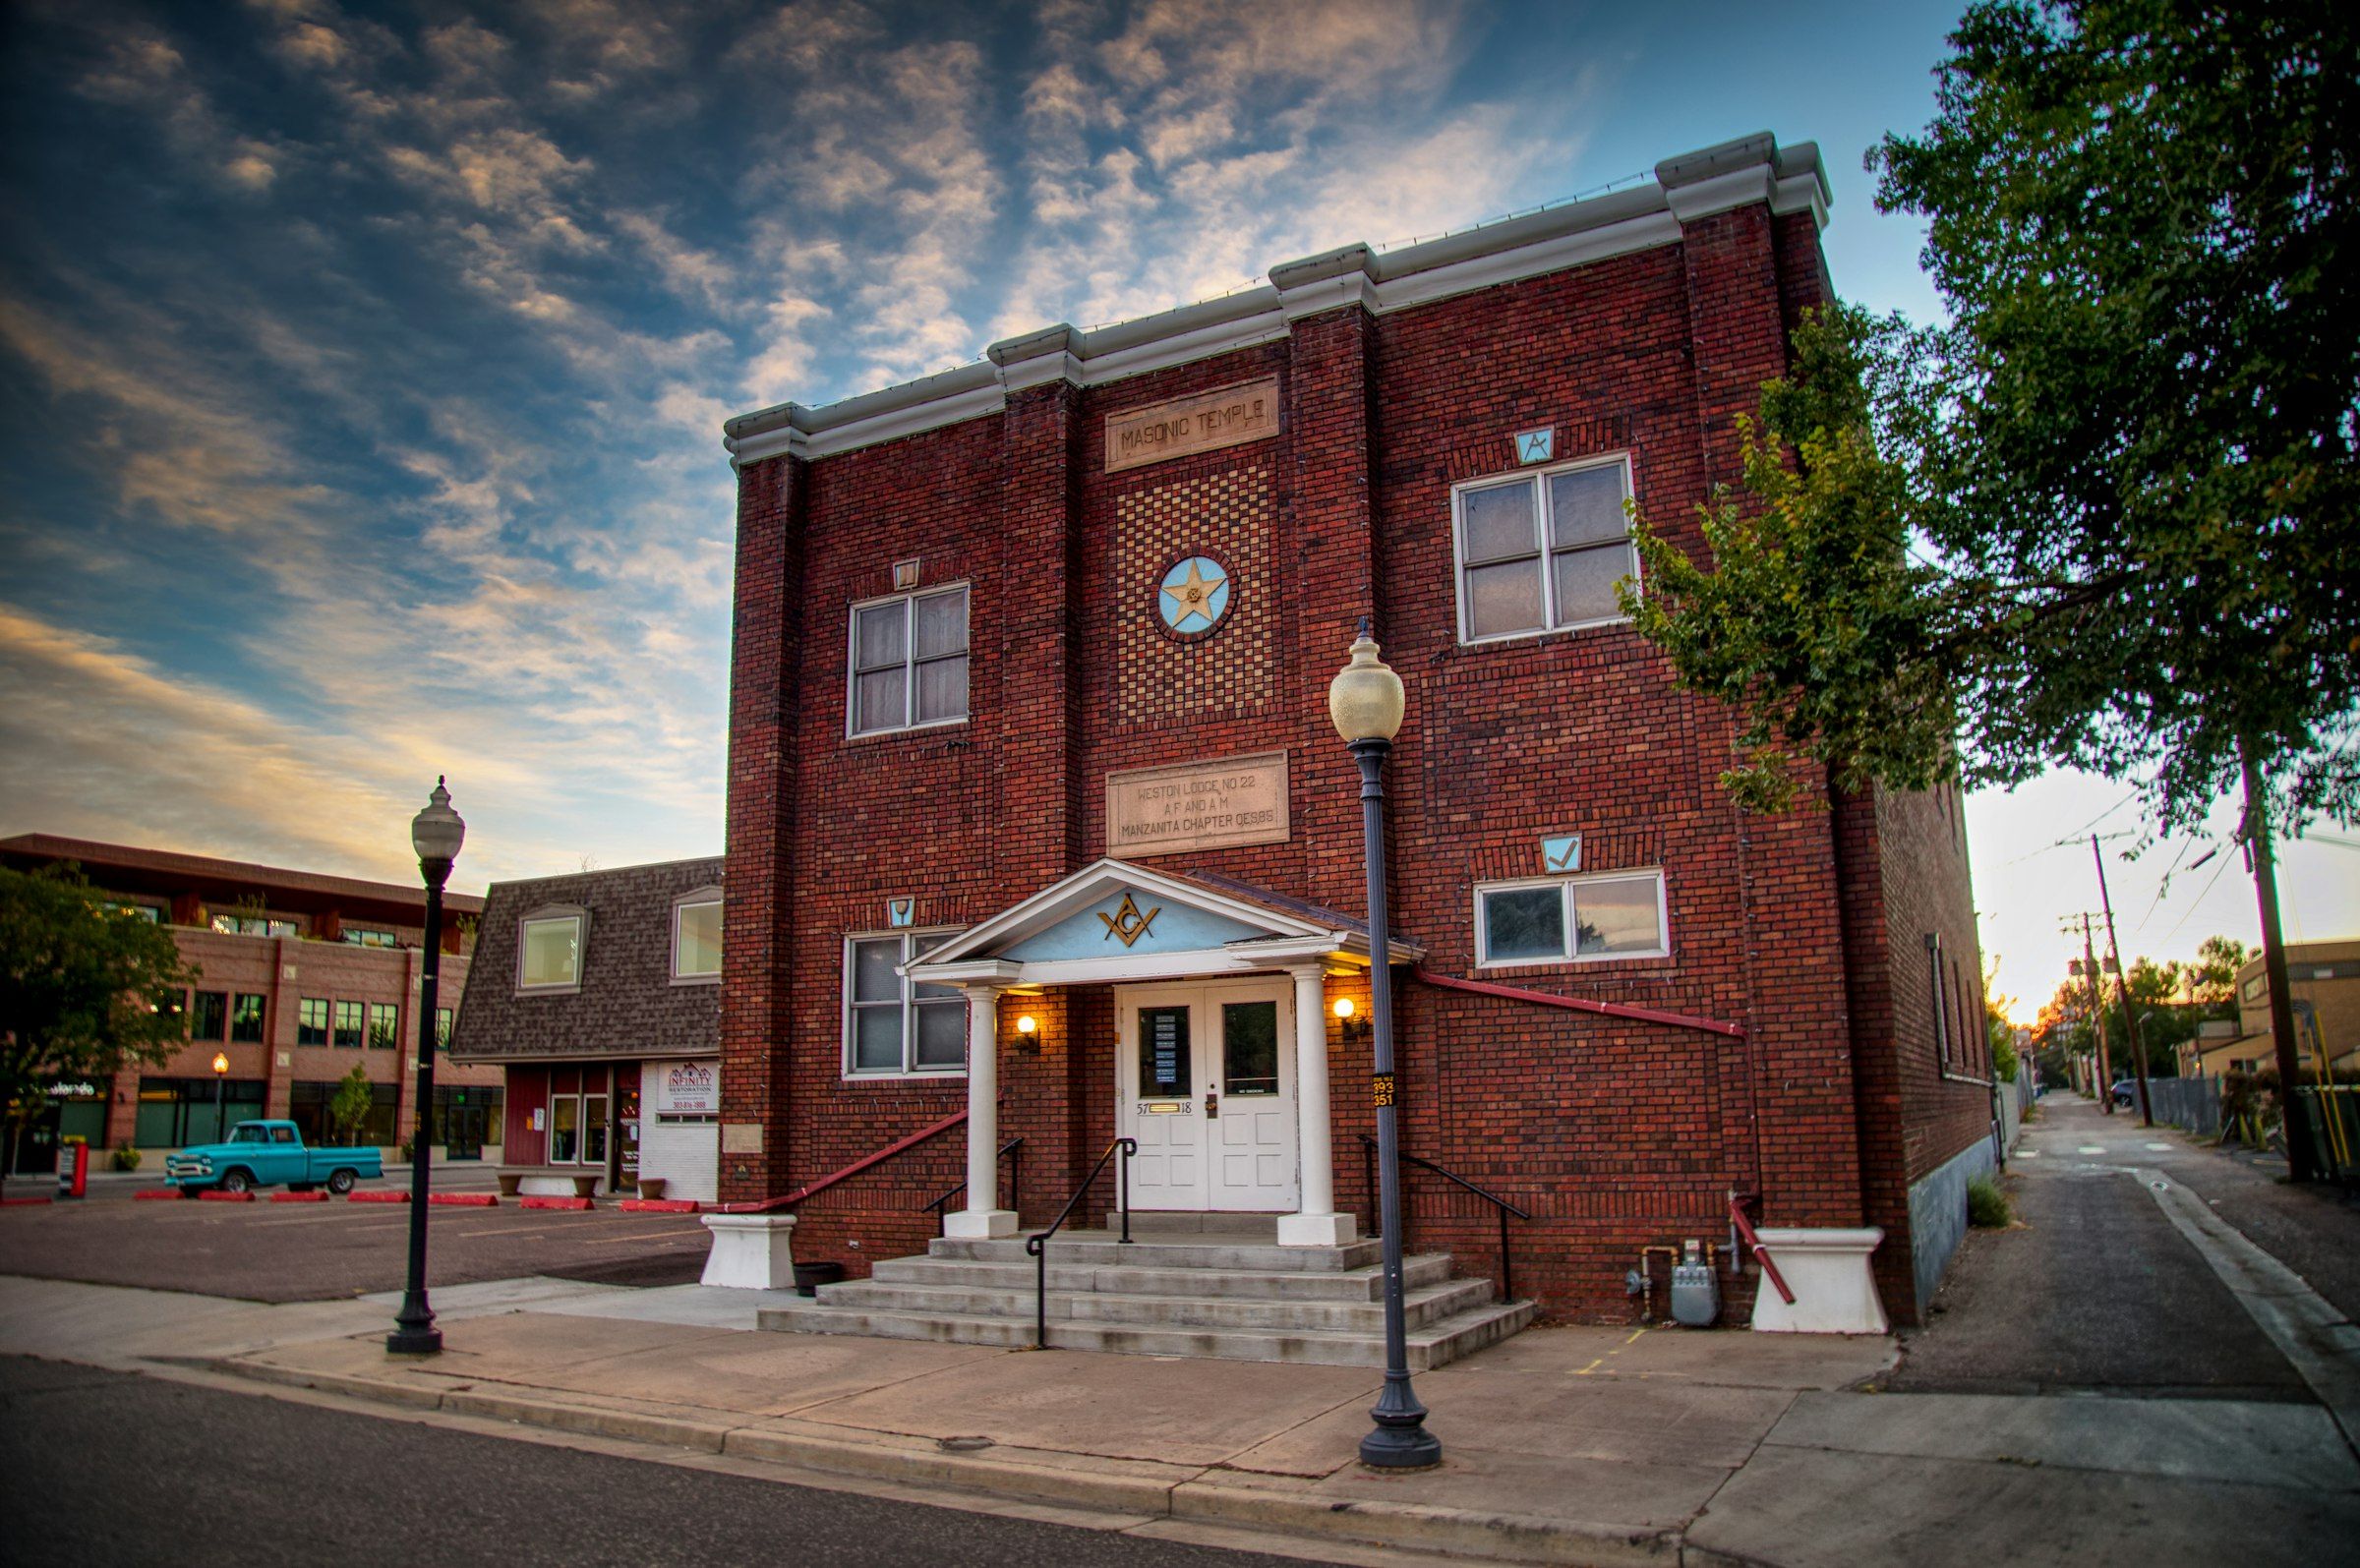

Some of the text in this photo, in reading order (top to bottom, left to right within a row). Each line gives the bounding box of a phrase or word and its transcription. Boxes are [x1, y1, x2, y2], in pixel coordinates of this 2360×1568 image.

[1121, 399, 1264, 449] MASONIC TEMPLE
[1138, 784, 1180, 799] WESTON
[1240, 776, 1255, 787] 22
[1164, 796, 1228, 815] A F AND A M
[1121, 820, 1180, 837] MANZANITA
[1183, 814, 1233, 831] CHAPTER
[669, 1076, 712, 1086] INFINITY
[1373, 1081, 1394, 1094] 393
[1137, 1101, 1192, 1115] 57 18
[1373, 1093, 1393, 1107] 351
